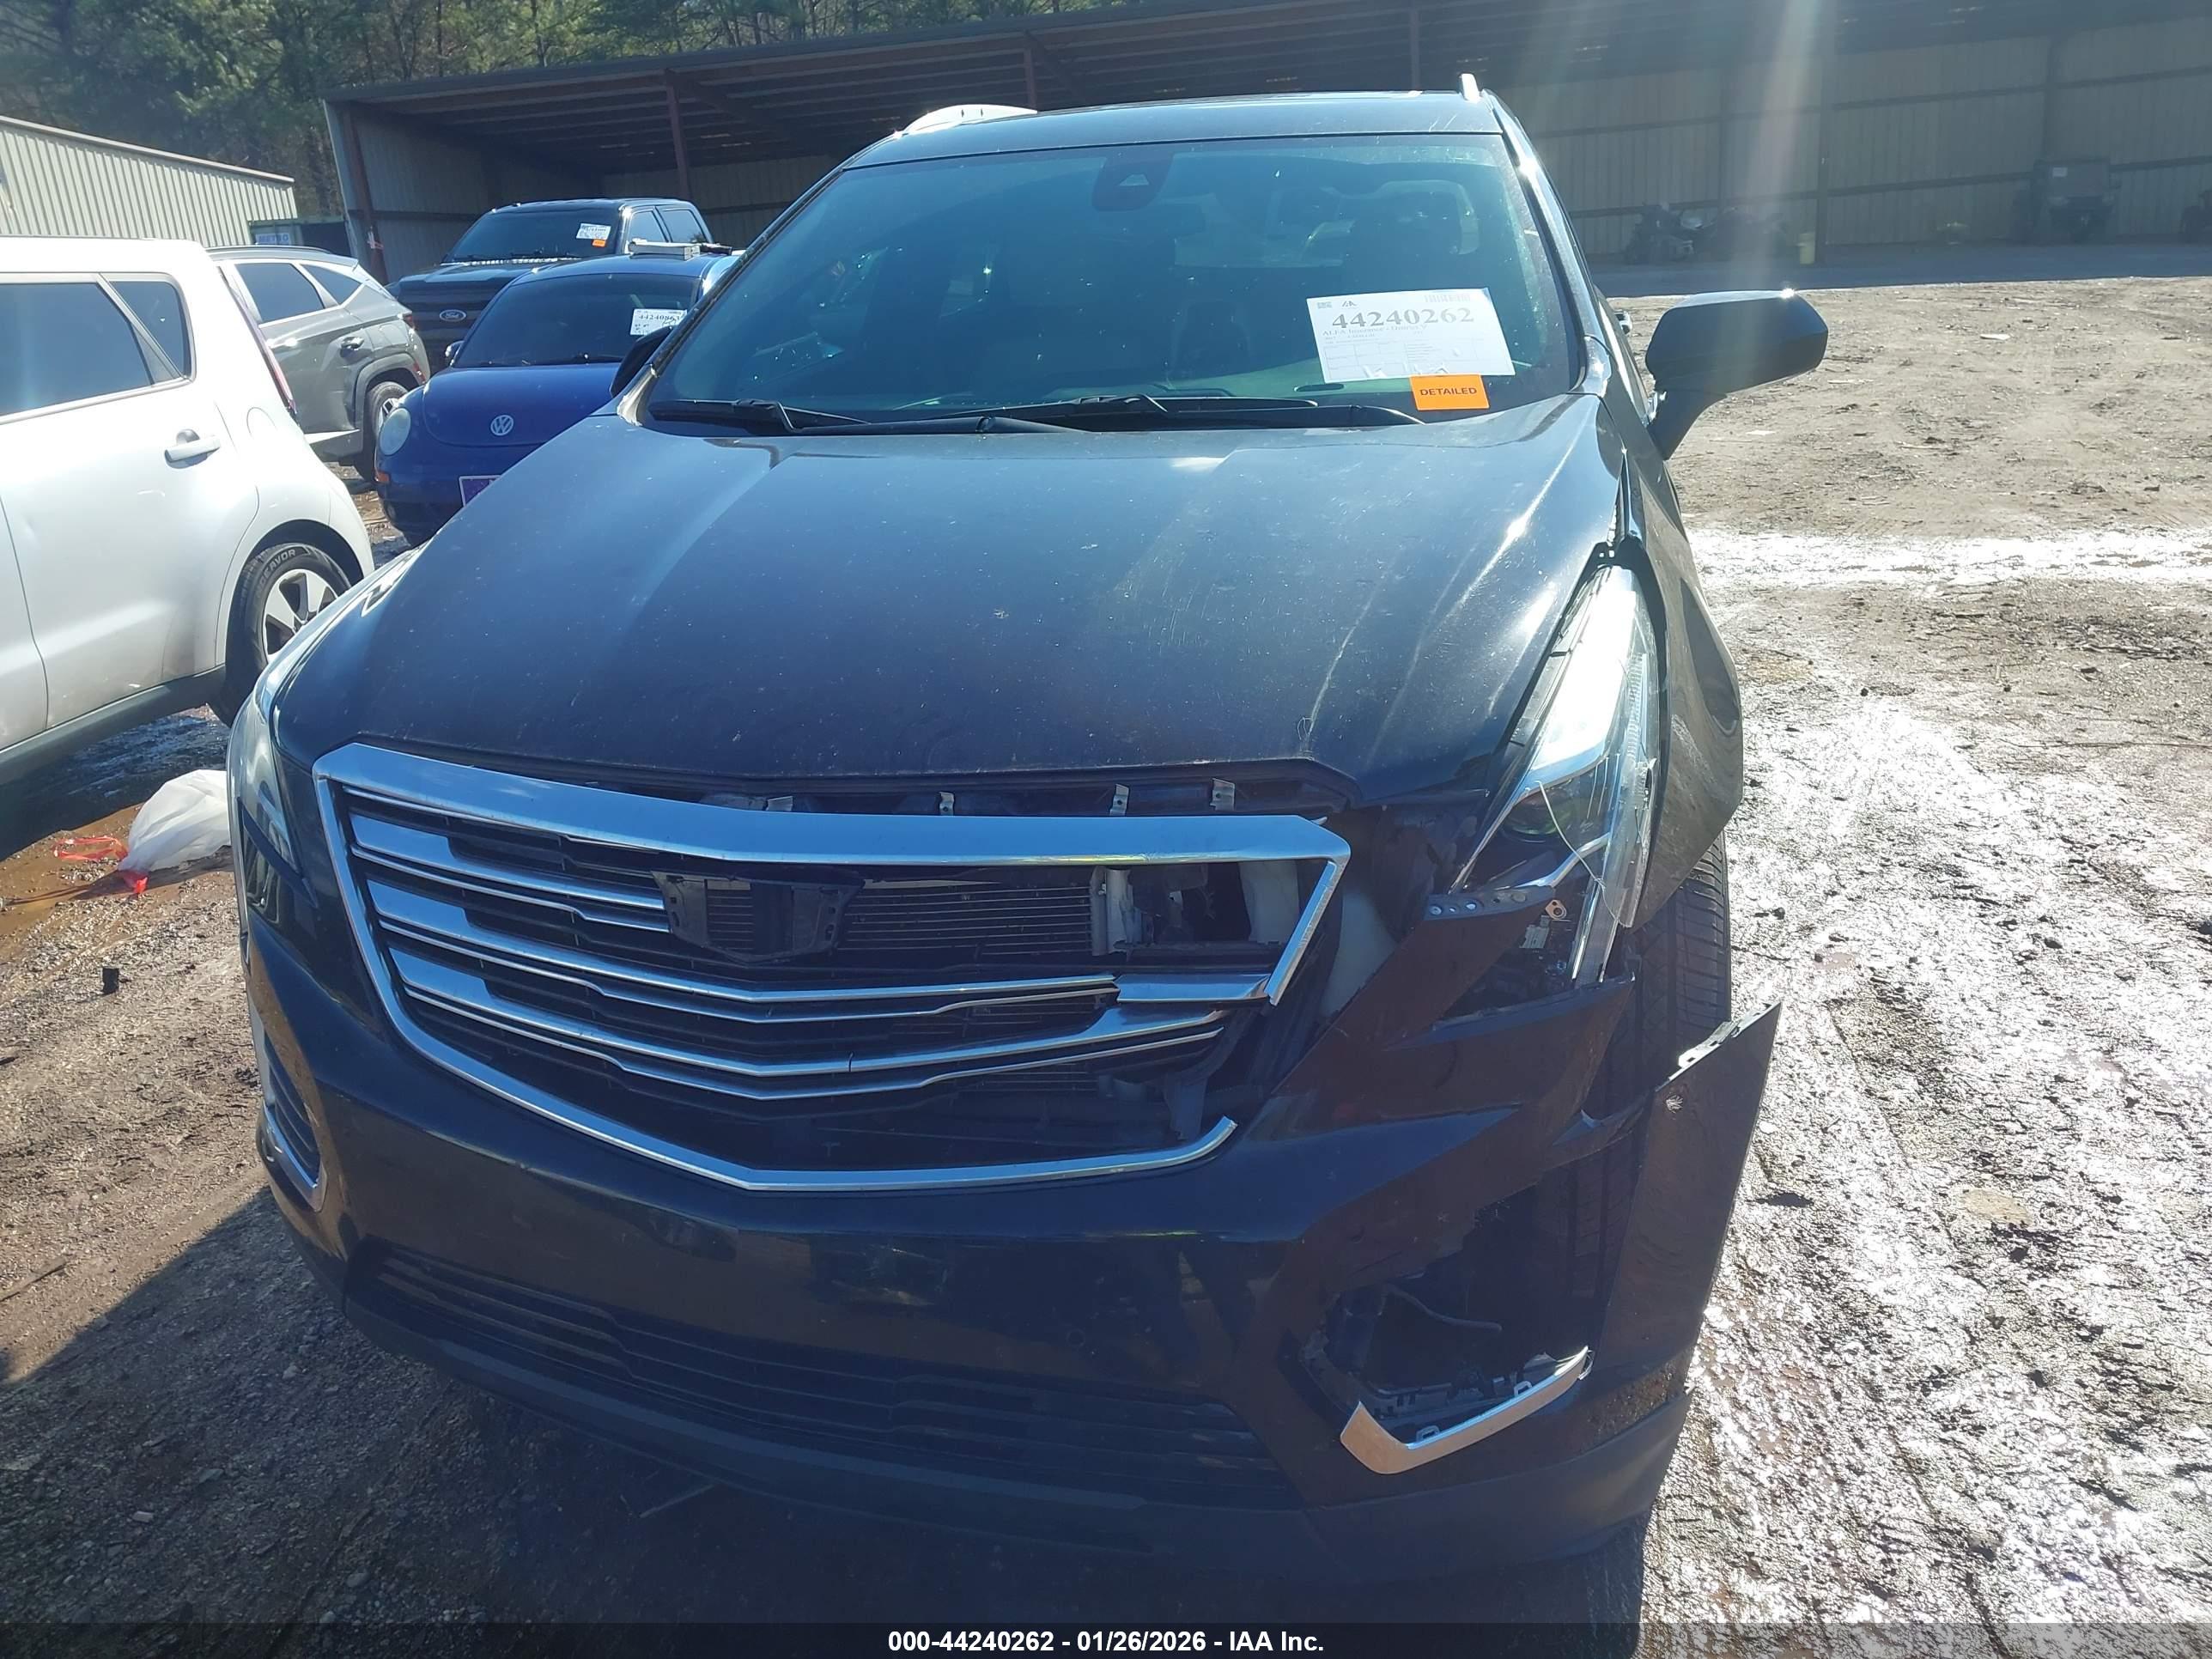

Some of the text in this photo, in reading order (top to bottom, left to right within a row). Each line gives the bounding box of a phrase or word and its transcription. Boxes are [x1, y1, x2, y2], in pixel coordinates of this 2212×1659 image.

[1332, 307, 1474, 328] 44240262
[1419, 387, 1478, 396] DETAILED
[257, 549, 296, 599] DEAVOR
